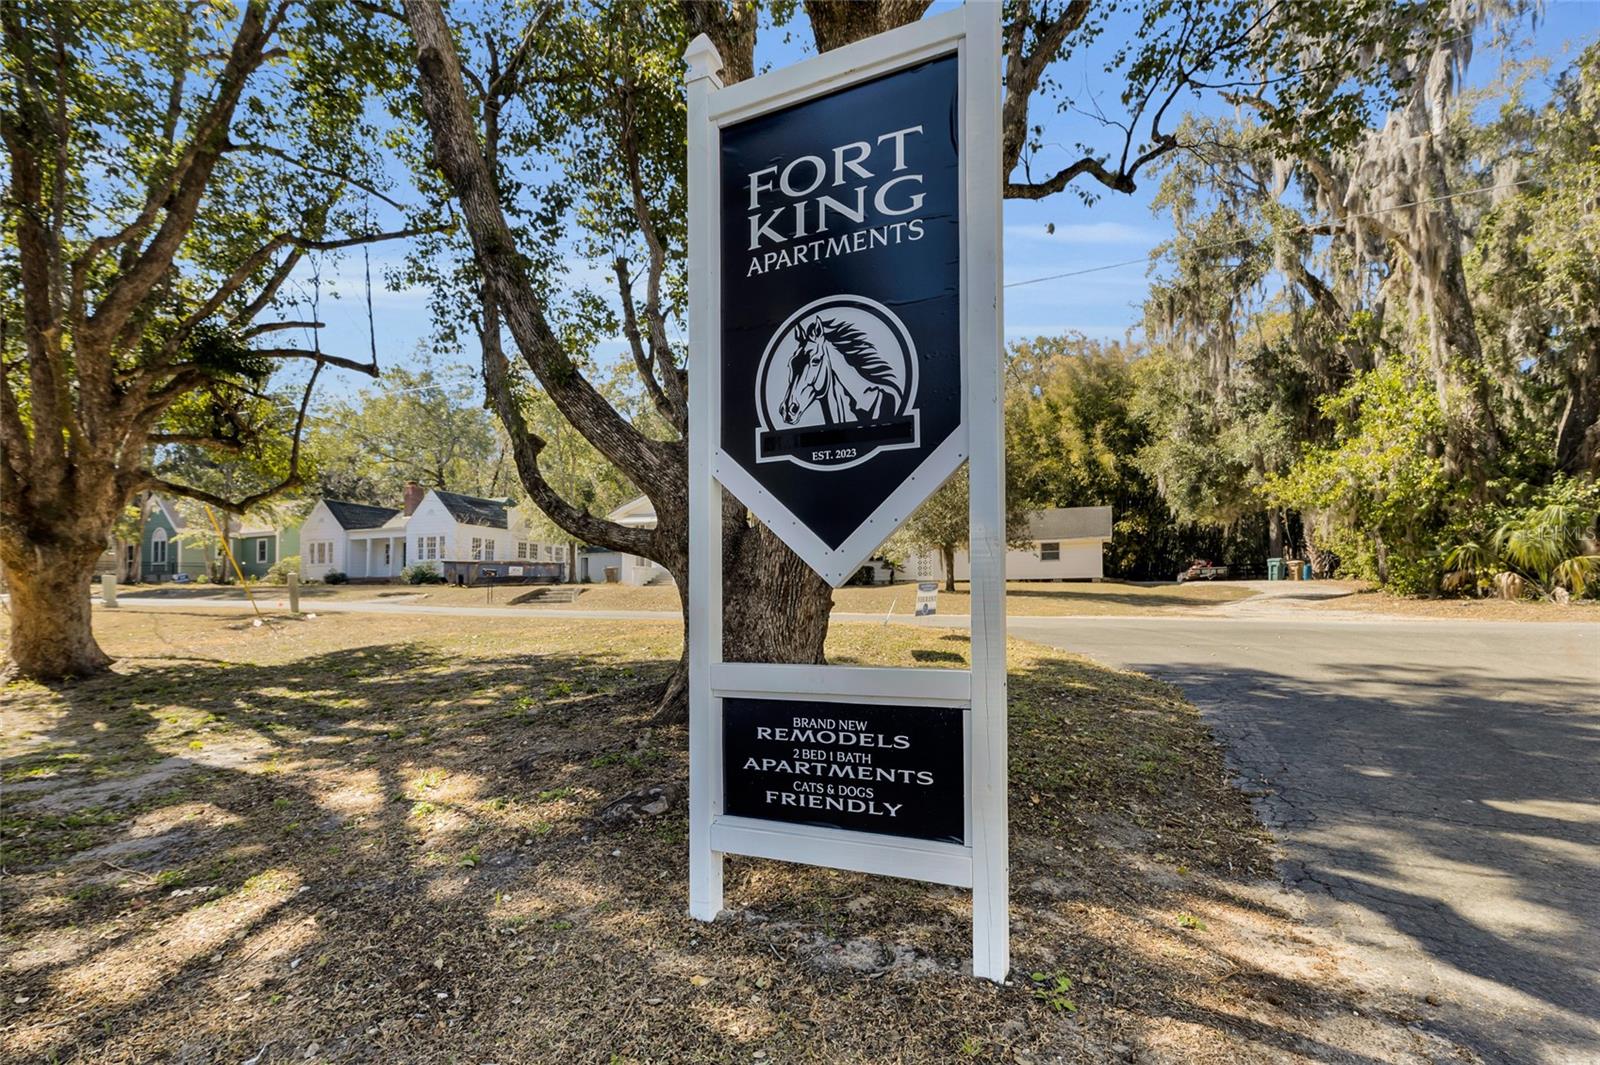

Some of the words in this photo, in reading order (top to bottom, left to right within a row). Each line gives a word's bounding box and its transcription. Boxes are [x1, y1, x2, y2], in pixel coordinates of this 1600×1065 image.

[747, 124, 924, 211] FORT
[746, 174, 927, 251] KING
[746, 218, 925, 277] APARTMENTS
[812, 450, 833, 461] EST.
[835, 448, 857, 459] 2023
[793, 717, 836, 730] BRAND
[838, 719, 868, 731] NEW
[757, 726, 911, 750] REMODELS
[793, 748, 800, 759] 2
[802, 749, 827, 761] BED
[836, 752, 872, 764] BATH
[744, 757, 934, 786] APARTMENTS
[793, 780, 825, 794] CATS
[826, 784, 835, 795] &
[838, 785, 874, 799] DOGS
[765, 790, 903, 817] FRIENDLY
